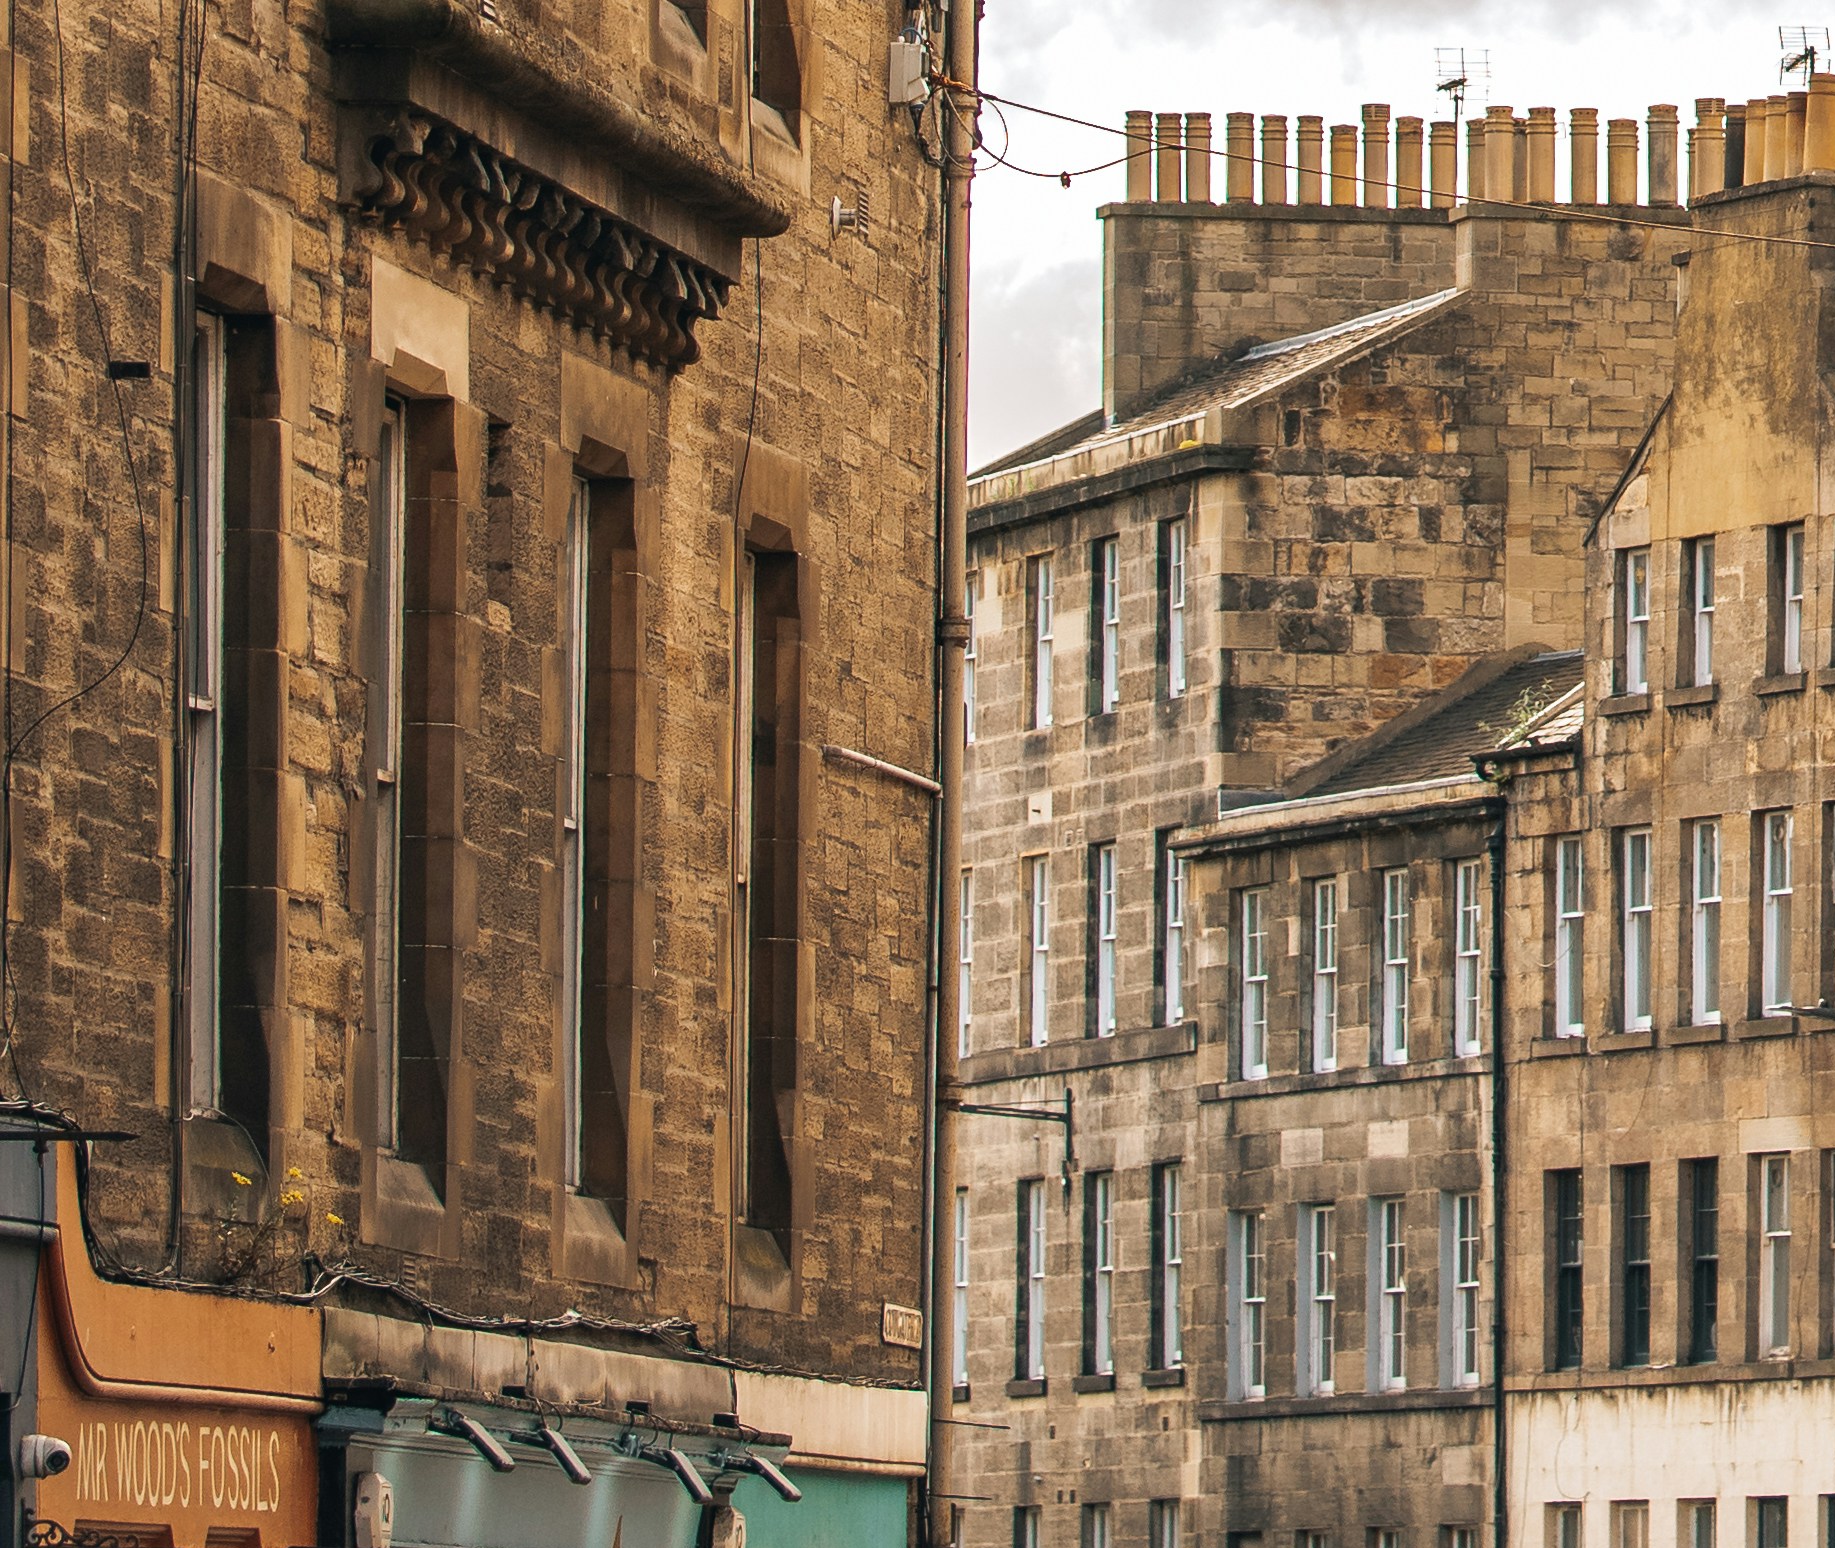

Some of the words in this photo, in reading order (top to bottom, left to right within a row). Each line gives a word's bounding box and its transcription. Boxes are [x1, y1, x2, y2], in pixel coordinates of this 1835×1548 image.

[77, 1421, 109, 1503] MR
[114, 1420, 191, 1509] WOOD'S
[199, 1424, 280, 1513] FOSSILS
